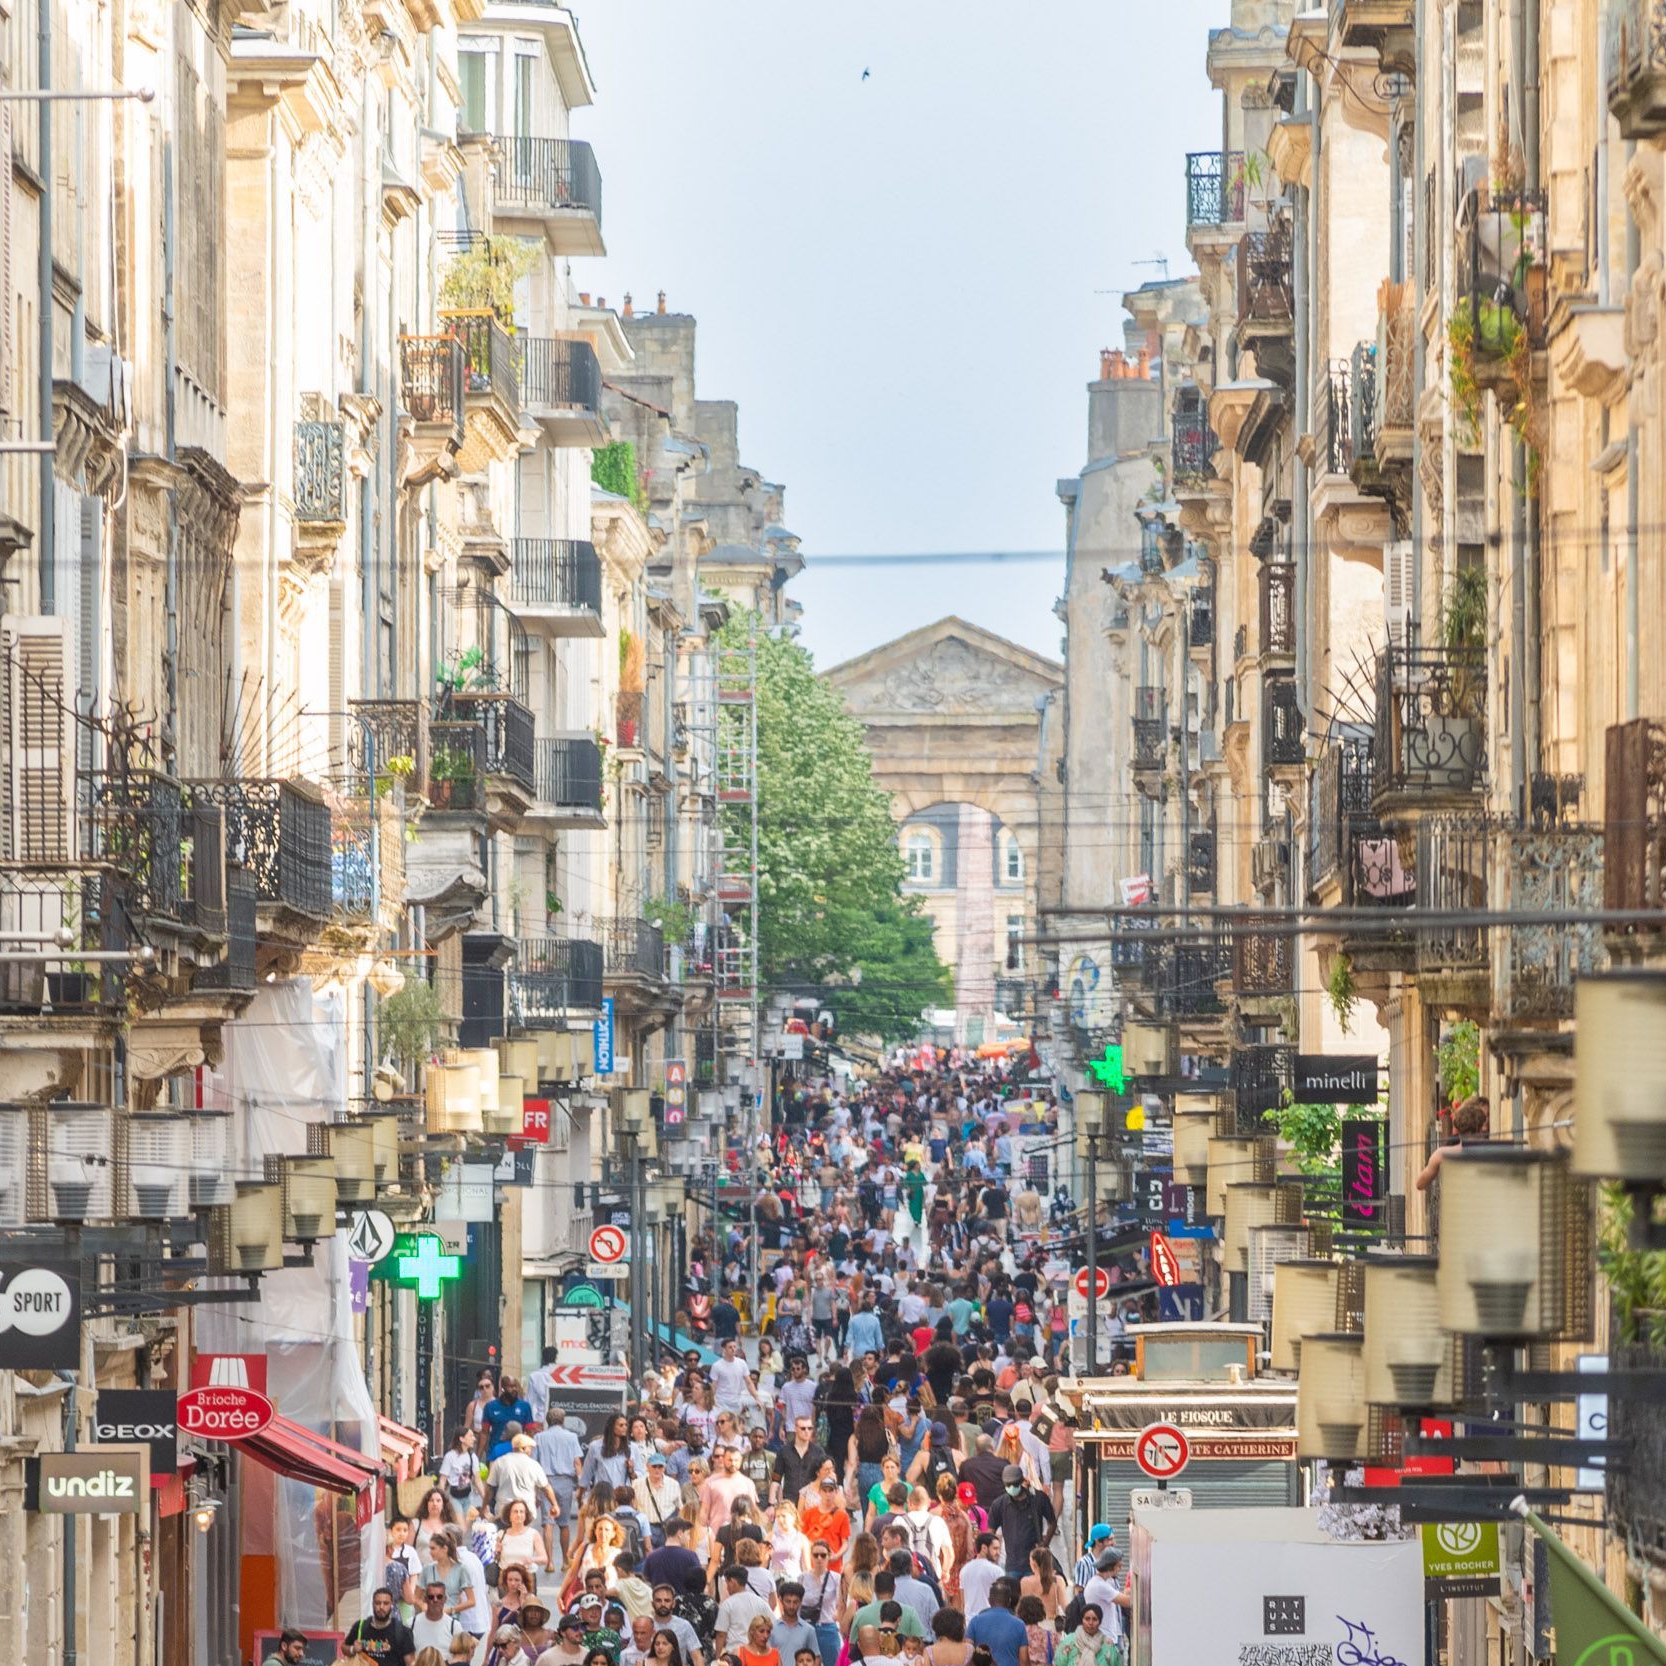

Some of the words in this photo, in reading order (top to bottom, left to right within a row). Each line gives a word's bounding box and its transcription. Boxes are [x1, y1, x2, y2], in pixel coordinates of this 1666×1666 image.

[1306, 1072, 1366, 1090] minelli
[14, 1291, 62, 1313] SPORT
[196, 1392, 247, 1406] Brioche
[185, 1404, 259, 1429] Dorée
[1160, 1411, 1172, 1423] LE
[1180, 1410, 1233, 1424] KIOSQUE
[96, 1423, 176, 1439] GEOX
[1213, 1442, 1290, 1455] CATHERINE
[48, 1470, 133, 1497] undiz
[1429, 1562, 1452, 1572] YVES
[1456, 1561, 1494, 1570] ROCHER
[1440, 1584, 1485, 1593] L'INSTITUT
